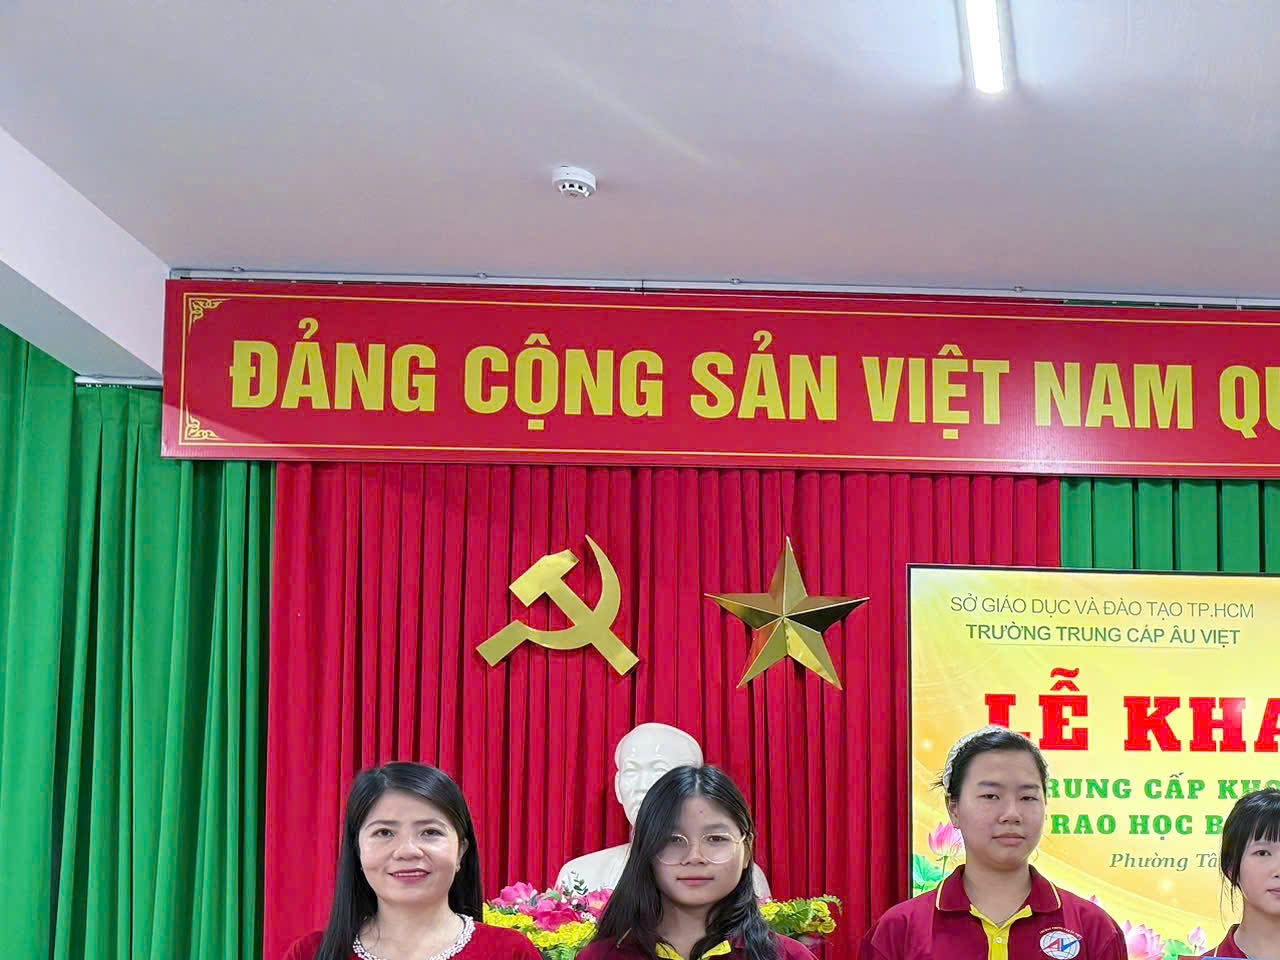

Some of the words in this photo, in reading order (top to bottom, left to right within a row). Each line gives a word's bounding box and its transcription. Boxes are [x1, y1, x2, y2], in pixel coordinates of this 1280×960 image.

[230, 317, 436, 412] ĐẢNG
[465, 333, 663, 430] CỘNG
[691, 329, 838, 422] SẢN
[862, 343, 1011, 440] VIỆT
[1035, 361, 1193, 430] NAM
[950, 593, 978, 613] SỞ
[982, 595, 1027, 613] GIÁO
[1032, 599, 1070, 618] DỤC
[1075, 597, 1099, 615] VÀ
[1103, 597, 1142, 616] ĐÀO
[1147, 601, 1183, 621] TẠO
[1187, 602, 1254, 618] TP.HCM
[966, 621, 1051, 641] TRƯỜNG
[1056, 626, 1121, 642] TRUNG
[1169, 625, 1196, 644] ÂU
[985, 668, 1088, 751] LỄ
[1046, 778, 1132, 799] RUNG
[1144, 772, 1205, 799] CẤP
[1045, 814, 1116, 834] RAO
[1129, 814, 1193, 840] HỌC
[1109, 852, 1188, 871] Phường
[1196, 852, 1219, 868] Tâ
